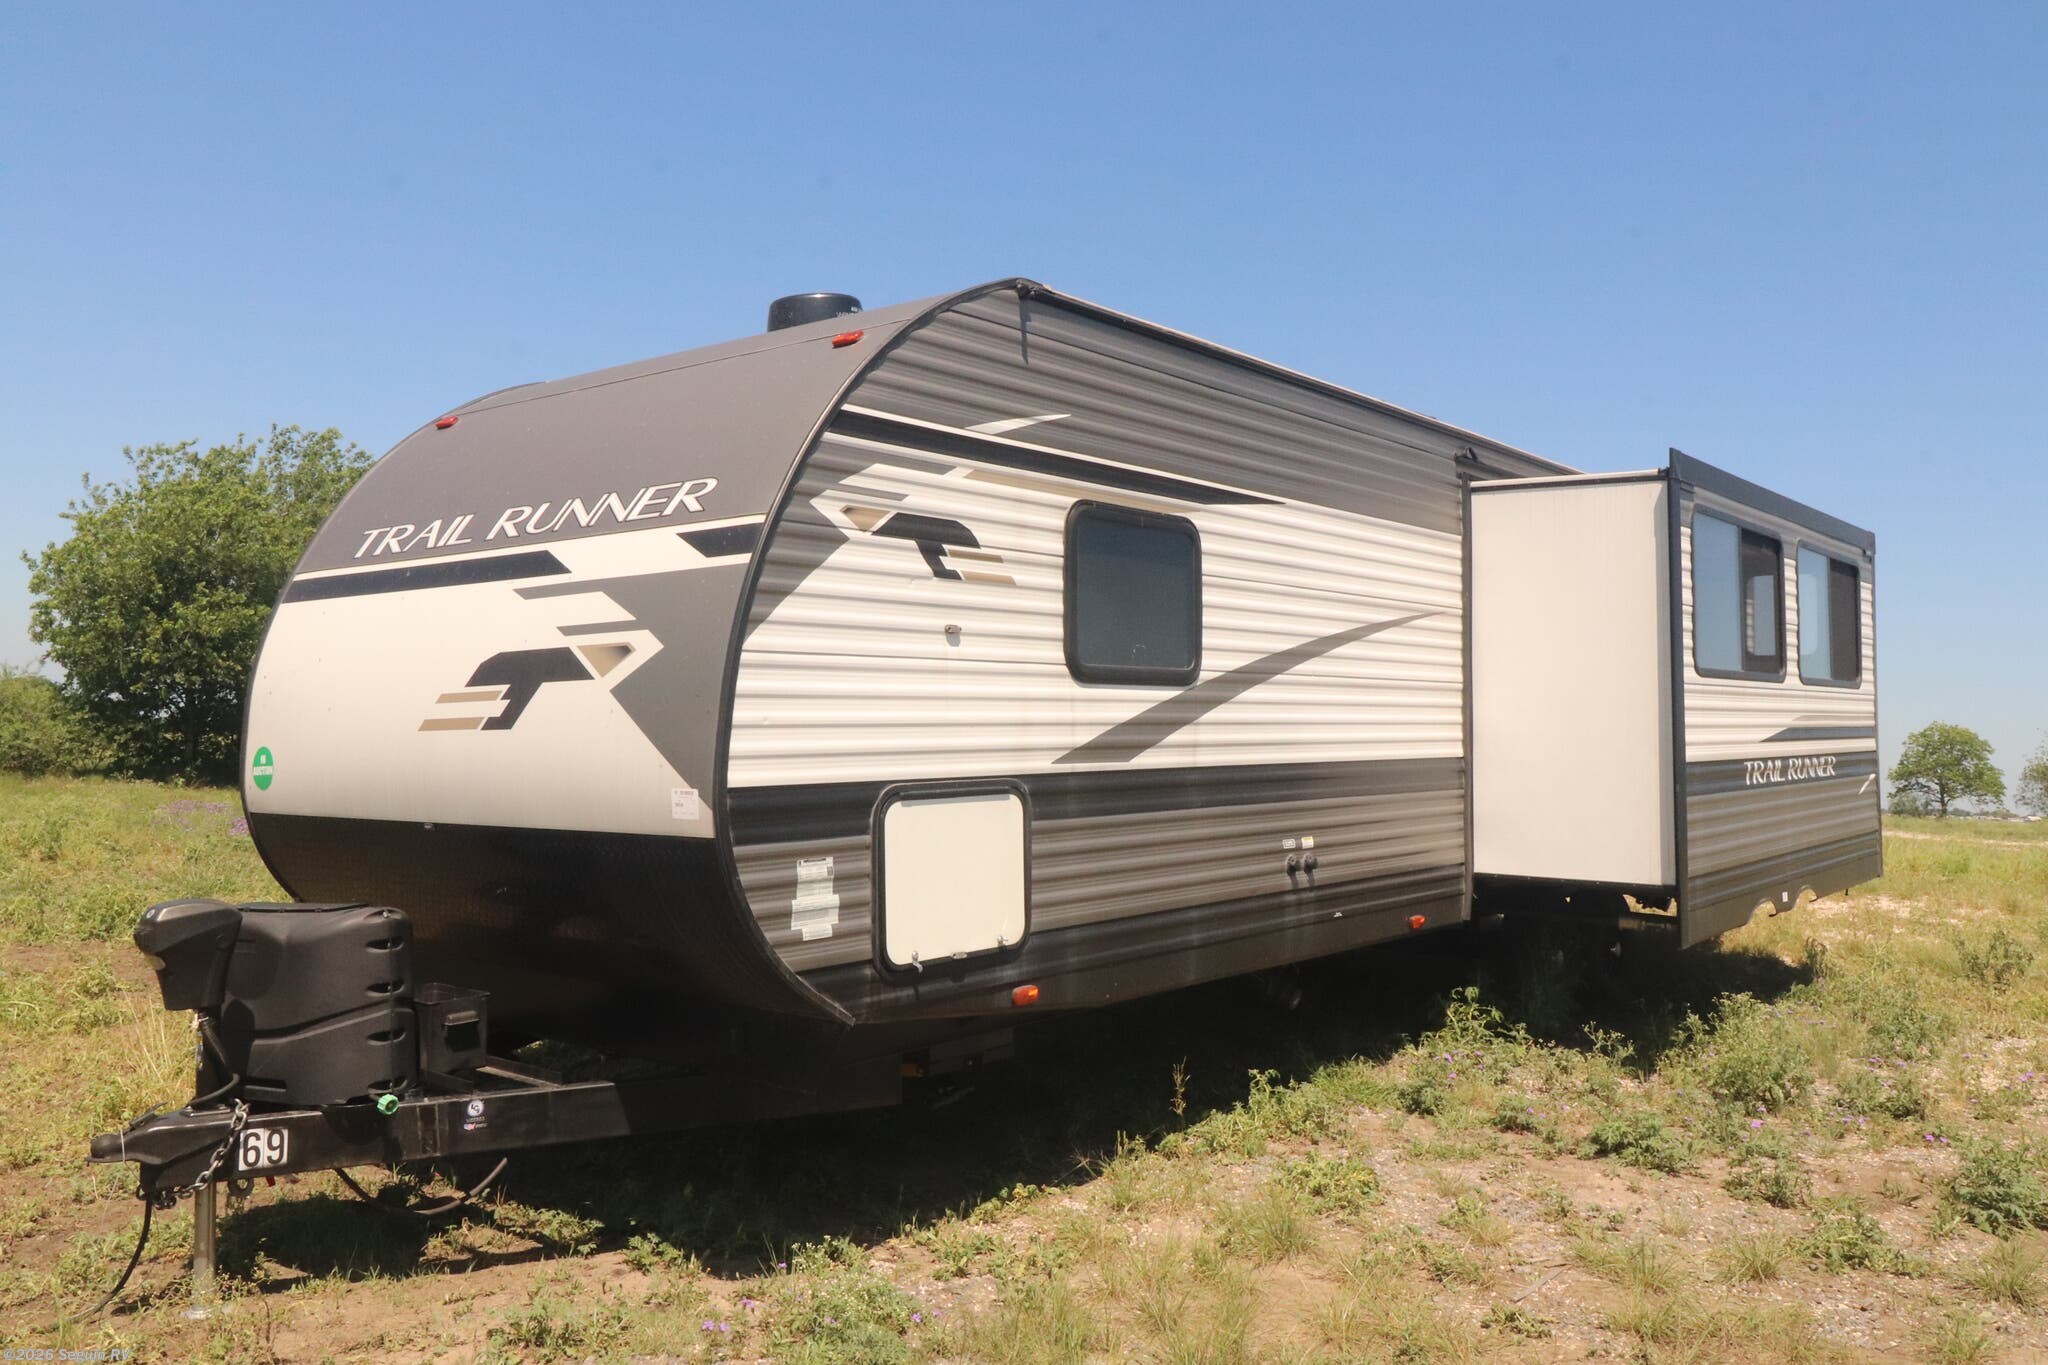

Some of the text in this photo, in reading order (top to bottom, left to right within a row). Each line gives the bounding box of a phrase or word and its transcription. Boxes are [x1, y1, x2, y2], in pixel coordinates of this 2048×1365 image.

[354, 477, 719, 559] TRAIL RUNNER
[1743, 755, 1837, 786] TRAIL RUNNER
[242, 1129, 285, 1168] 69
